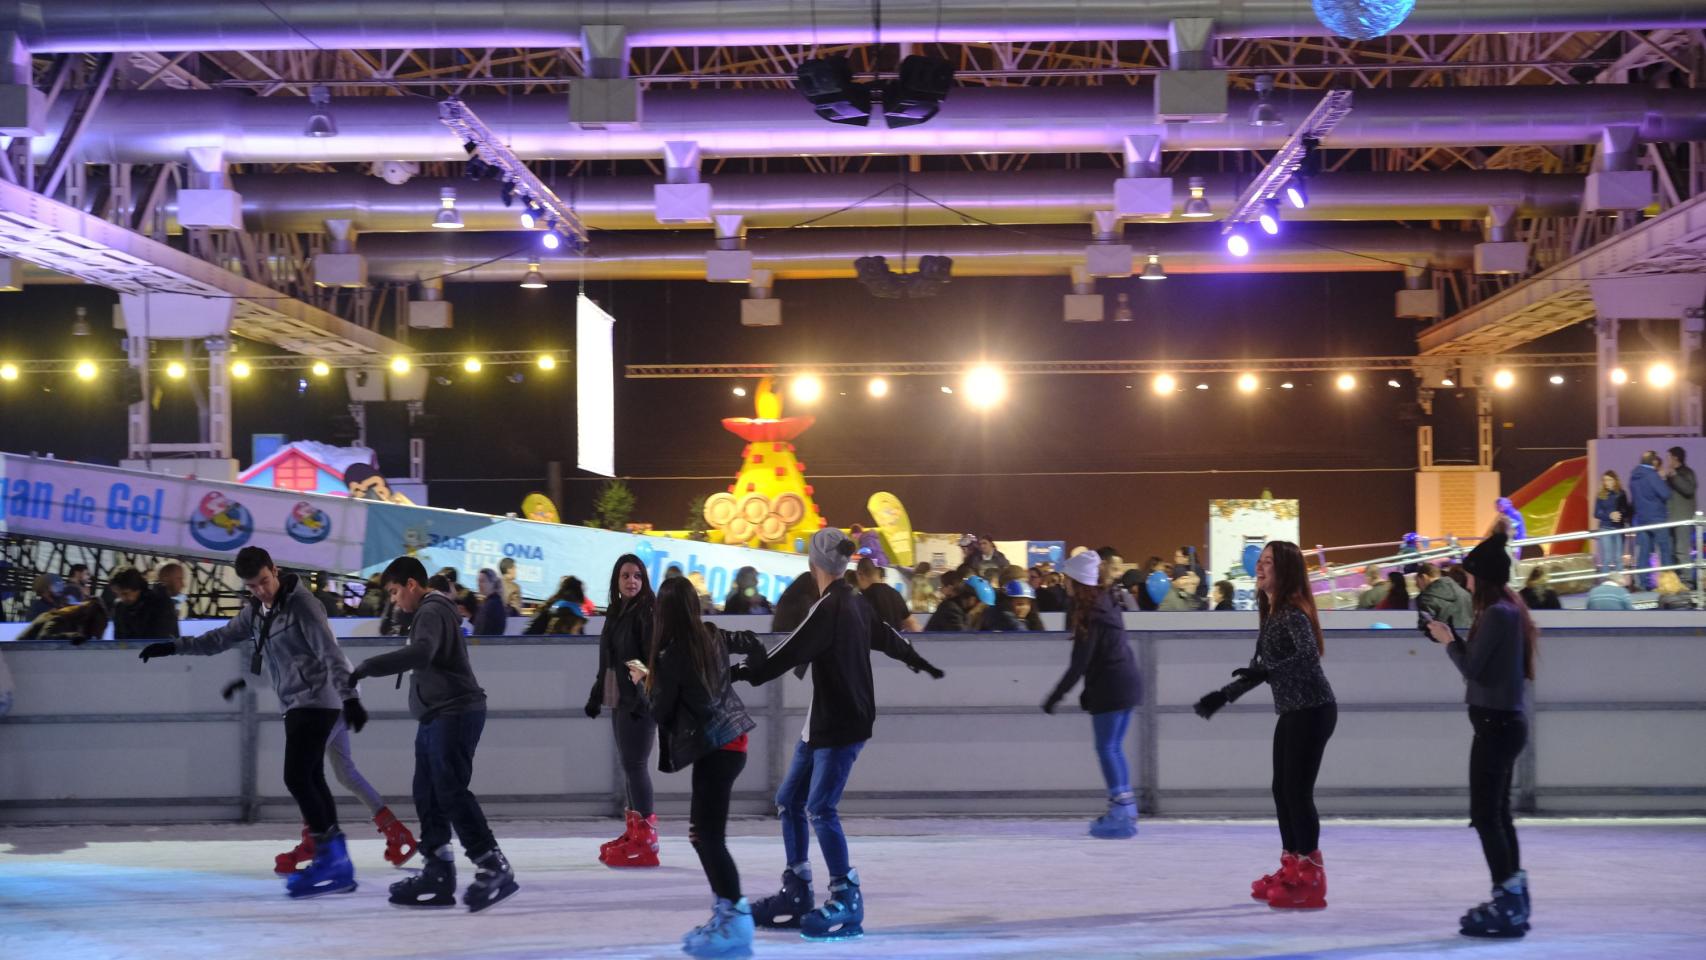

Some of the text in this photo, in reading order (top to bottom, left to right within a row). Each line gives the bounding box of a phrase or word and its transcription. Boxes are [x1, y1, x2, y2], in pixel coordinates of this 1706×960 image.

[62, 488, 96, 525] de
[106, 482, 164, 534] Gel
[648, 550, 795, 607] Tboan
